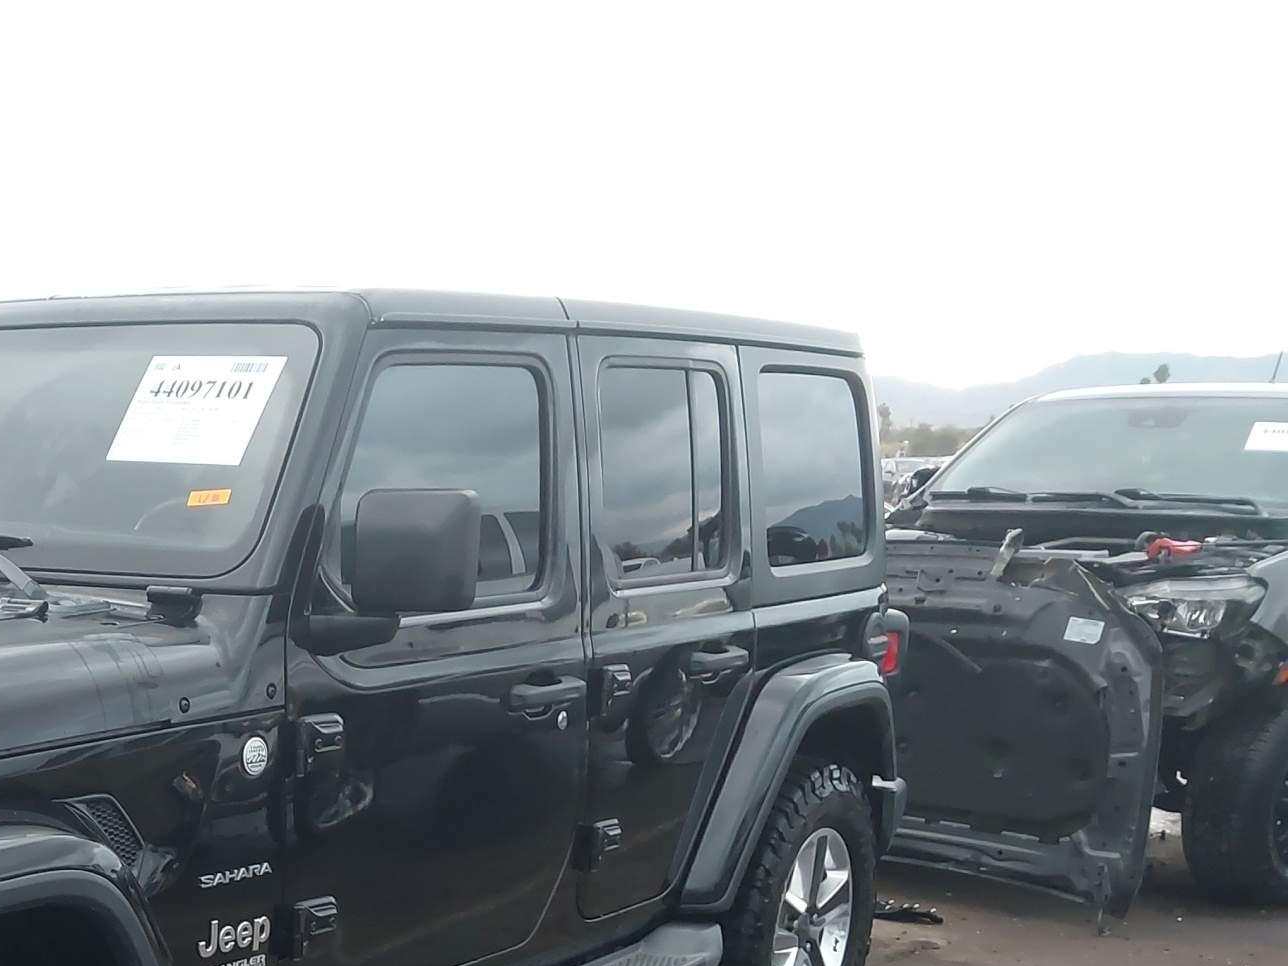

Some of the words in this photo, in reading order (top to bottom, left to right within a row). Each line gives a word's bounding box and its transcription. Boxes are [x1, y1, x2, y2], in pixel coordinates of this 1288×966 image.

[149, 379, 255, 399] 44097101
[199, 862, 273, 888] SAHARA
[198, 915, 271, 958] Jeep
